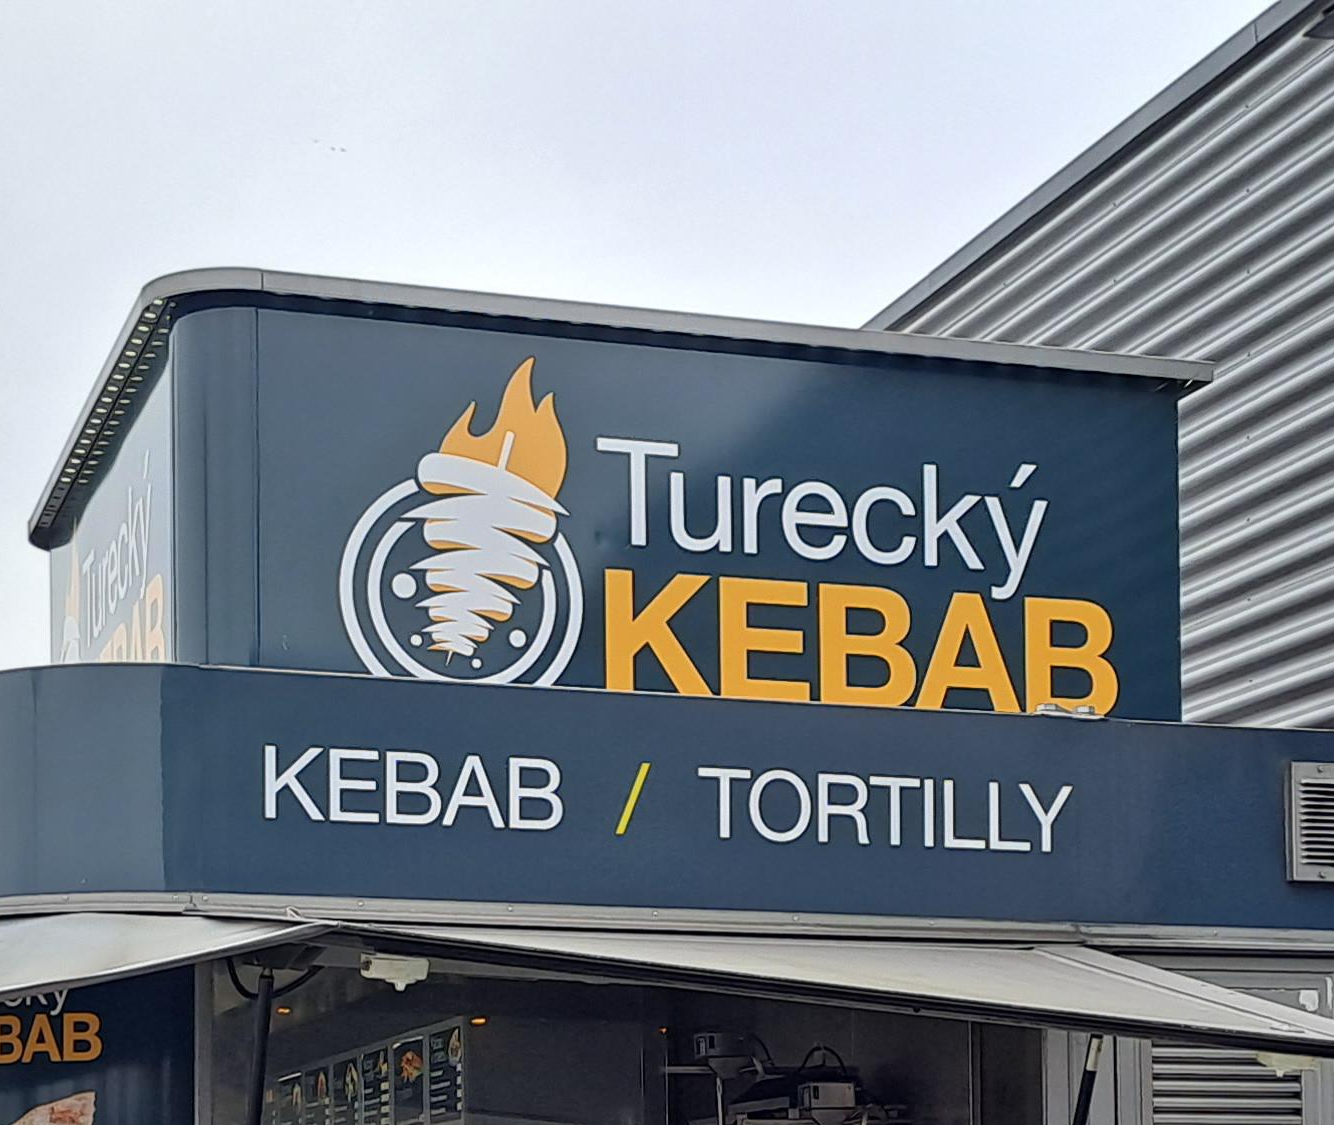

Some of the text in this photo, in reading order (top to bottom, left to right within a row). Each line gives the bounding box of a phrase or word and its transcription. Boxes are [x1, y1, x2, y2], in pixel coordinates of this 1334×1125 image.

[83, 449, 152, 648] Turecký
[596, 436, 1048, 600] Turecký
[604, 568, 1120, 718] KEBAB
[263, 745, 1073, 853] KEBAB / TORTILLY
